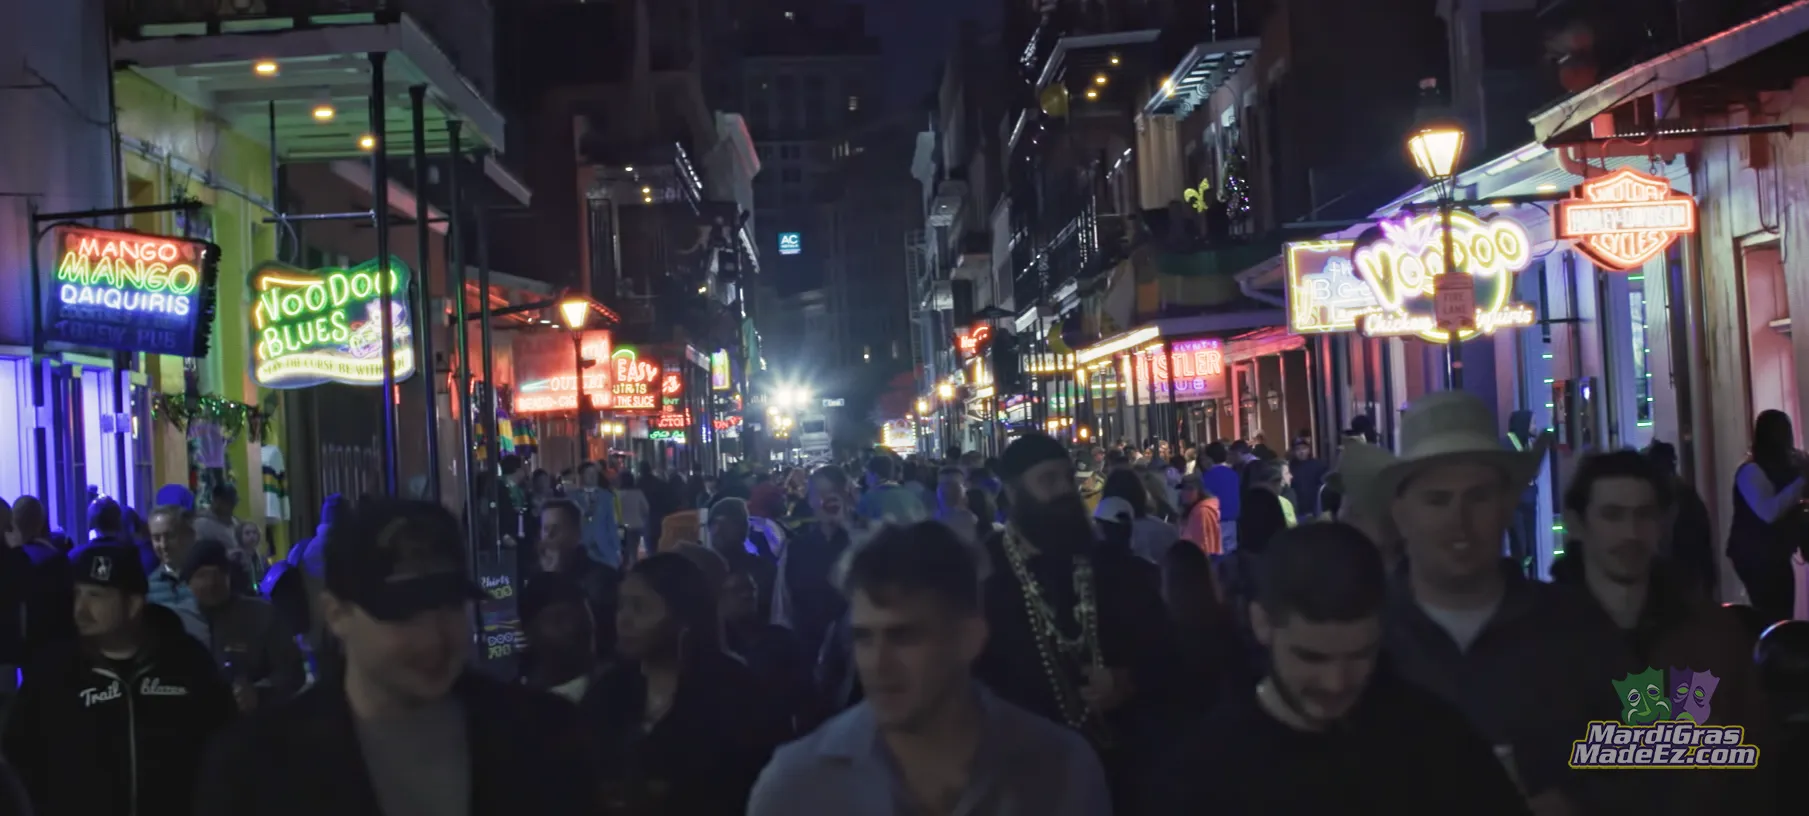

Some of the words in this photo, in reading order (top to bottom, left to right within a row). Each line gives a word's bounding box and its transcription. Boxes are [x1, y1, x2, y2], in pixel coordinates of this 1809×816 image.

[78, 238, 177, 262] MANGO
[781, 234, 798, 244] AC
[1602, 231, 1658, 256] CYCLES
[58, 251, 198, 294] MANGO
[1354, 218, 1530, 310] VOODOO
[60, 284, 190, 316] DAIQUIRIS
[263, 310, 348, 359] BLUES
[550, 374, 606, 392] OUTET
[617, 358, 657, 382] EASY
[80, 680, 122, 707] Trail
